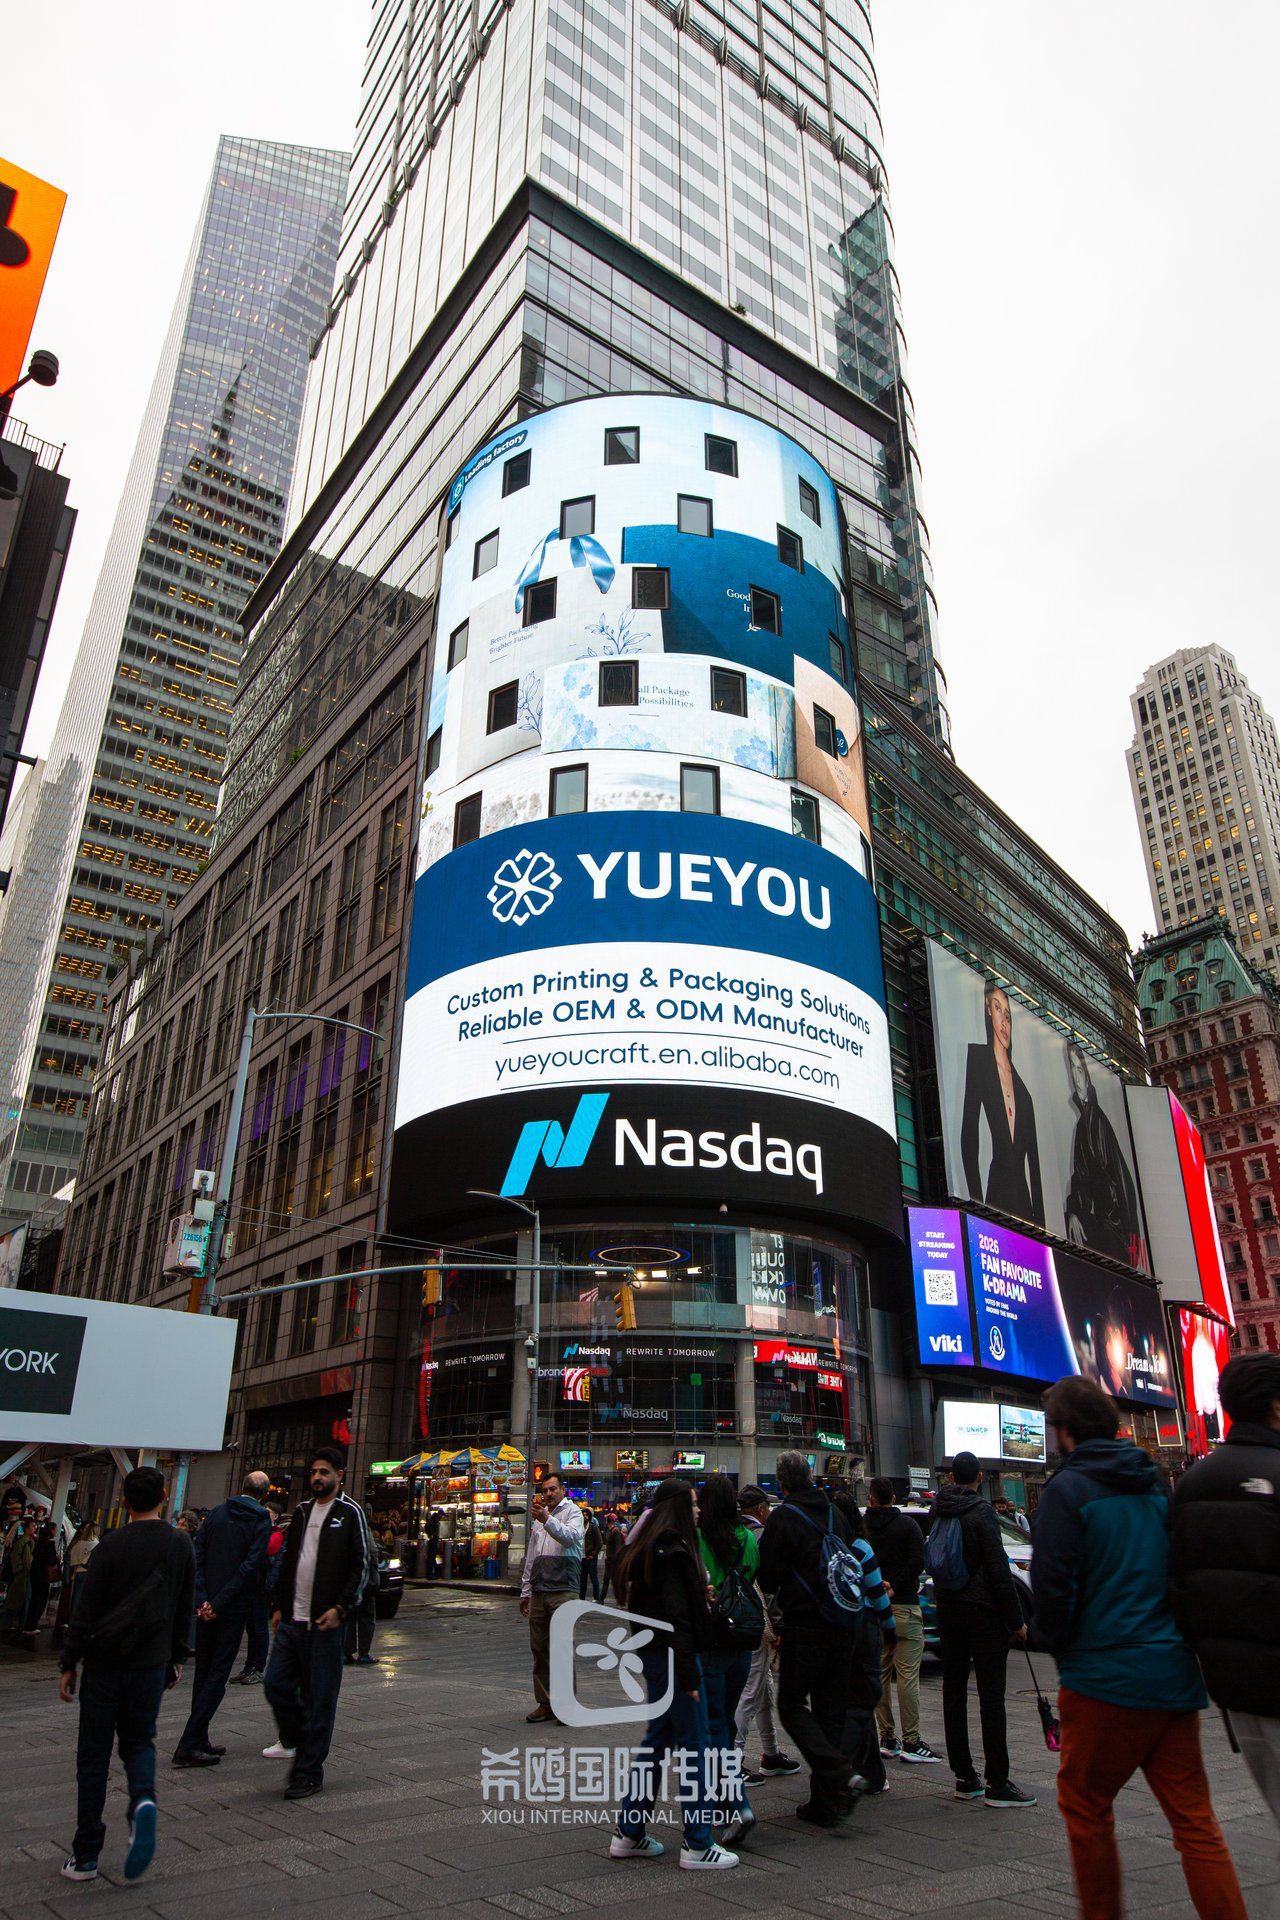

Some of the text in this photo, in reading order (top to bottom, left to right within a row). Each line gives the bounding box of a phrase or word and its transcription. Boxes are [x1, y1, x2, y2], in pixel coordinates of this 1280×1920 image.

[464, 433, 524, 484] Leading factory
[726, 588, 750, 602] Good
[490, 634, 508, 646] Better
[490, 633, 534, 654] Brighter Future
[652, 686, 690, 697] Package
[640, 696, 694, 708] Possibilities
[576, 851, 832, 930] YUEYOU
[447, 968, 870, 1034] Custom Printing & Packaging Solutions
[458, 998, 864, 1058] Reliable OEM & ODM Manufacturer
[495, 1042, 840, 1090] yueyoucraft.en.alibaba.com
[614, 1118, 824, 1196] Nasdaq
[918, 1241, 956, 1249] STREAMING
[978, 1234, 1000, 1254] 2026
[980, 1252, 1042, 1290] FAN FAVORITE
[982, 1274, 1027, 1304] K-DRAMA
[984, 1298, 996, 1306] VOTED
[986, 1306, 1000, 1315] AROUND
[1006, 1312, 1018, 1320] WORLD
[445, 1356, 467, 1366] REWRITE
[469, 1352, 506, 1364] TOMORROW
[578, 1346, 716, 1357] Nasdaq REWRITE TOMORROW
[818, 1359, 839, 1370] REWRITE
[1125, 1352, 1148, 1372] Dream
[1152, 1354, 1166, 1374] You
[623, 1408, 668, 1422] Nasdaq
